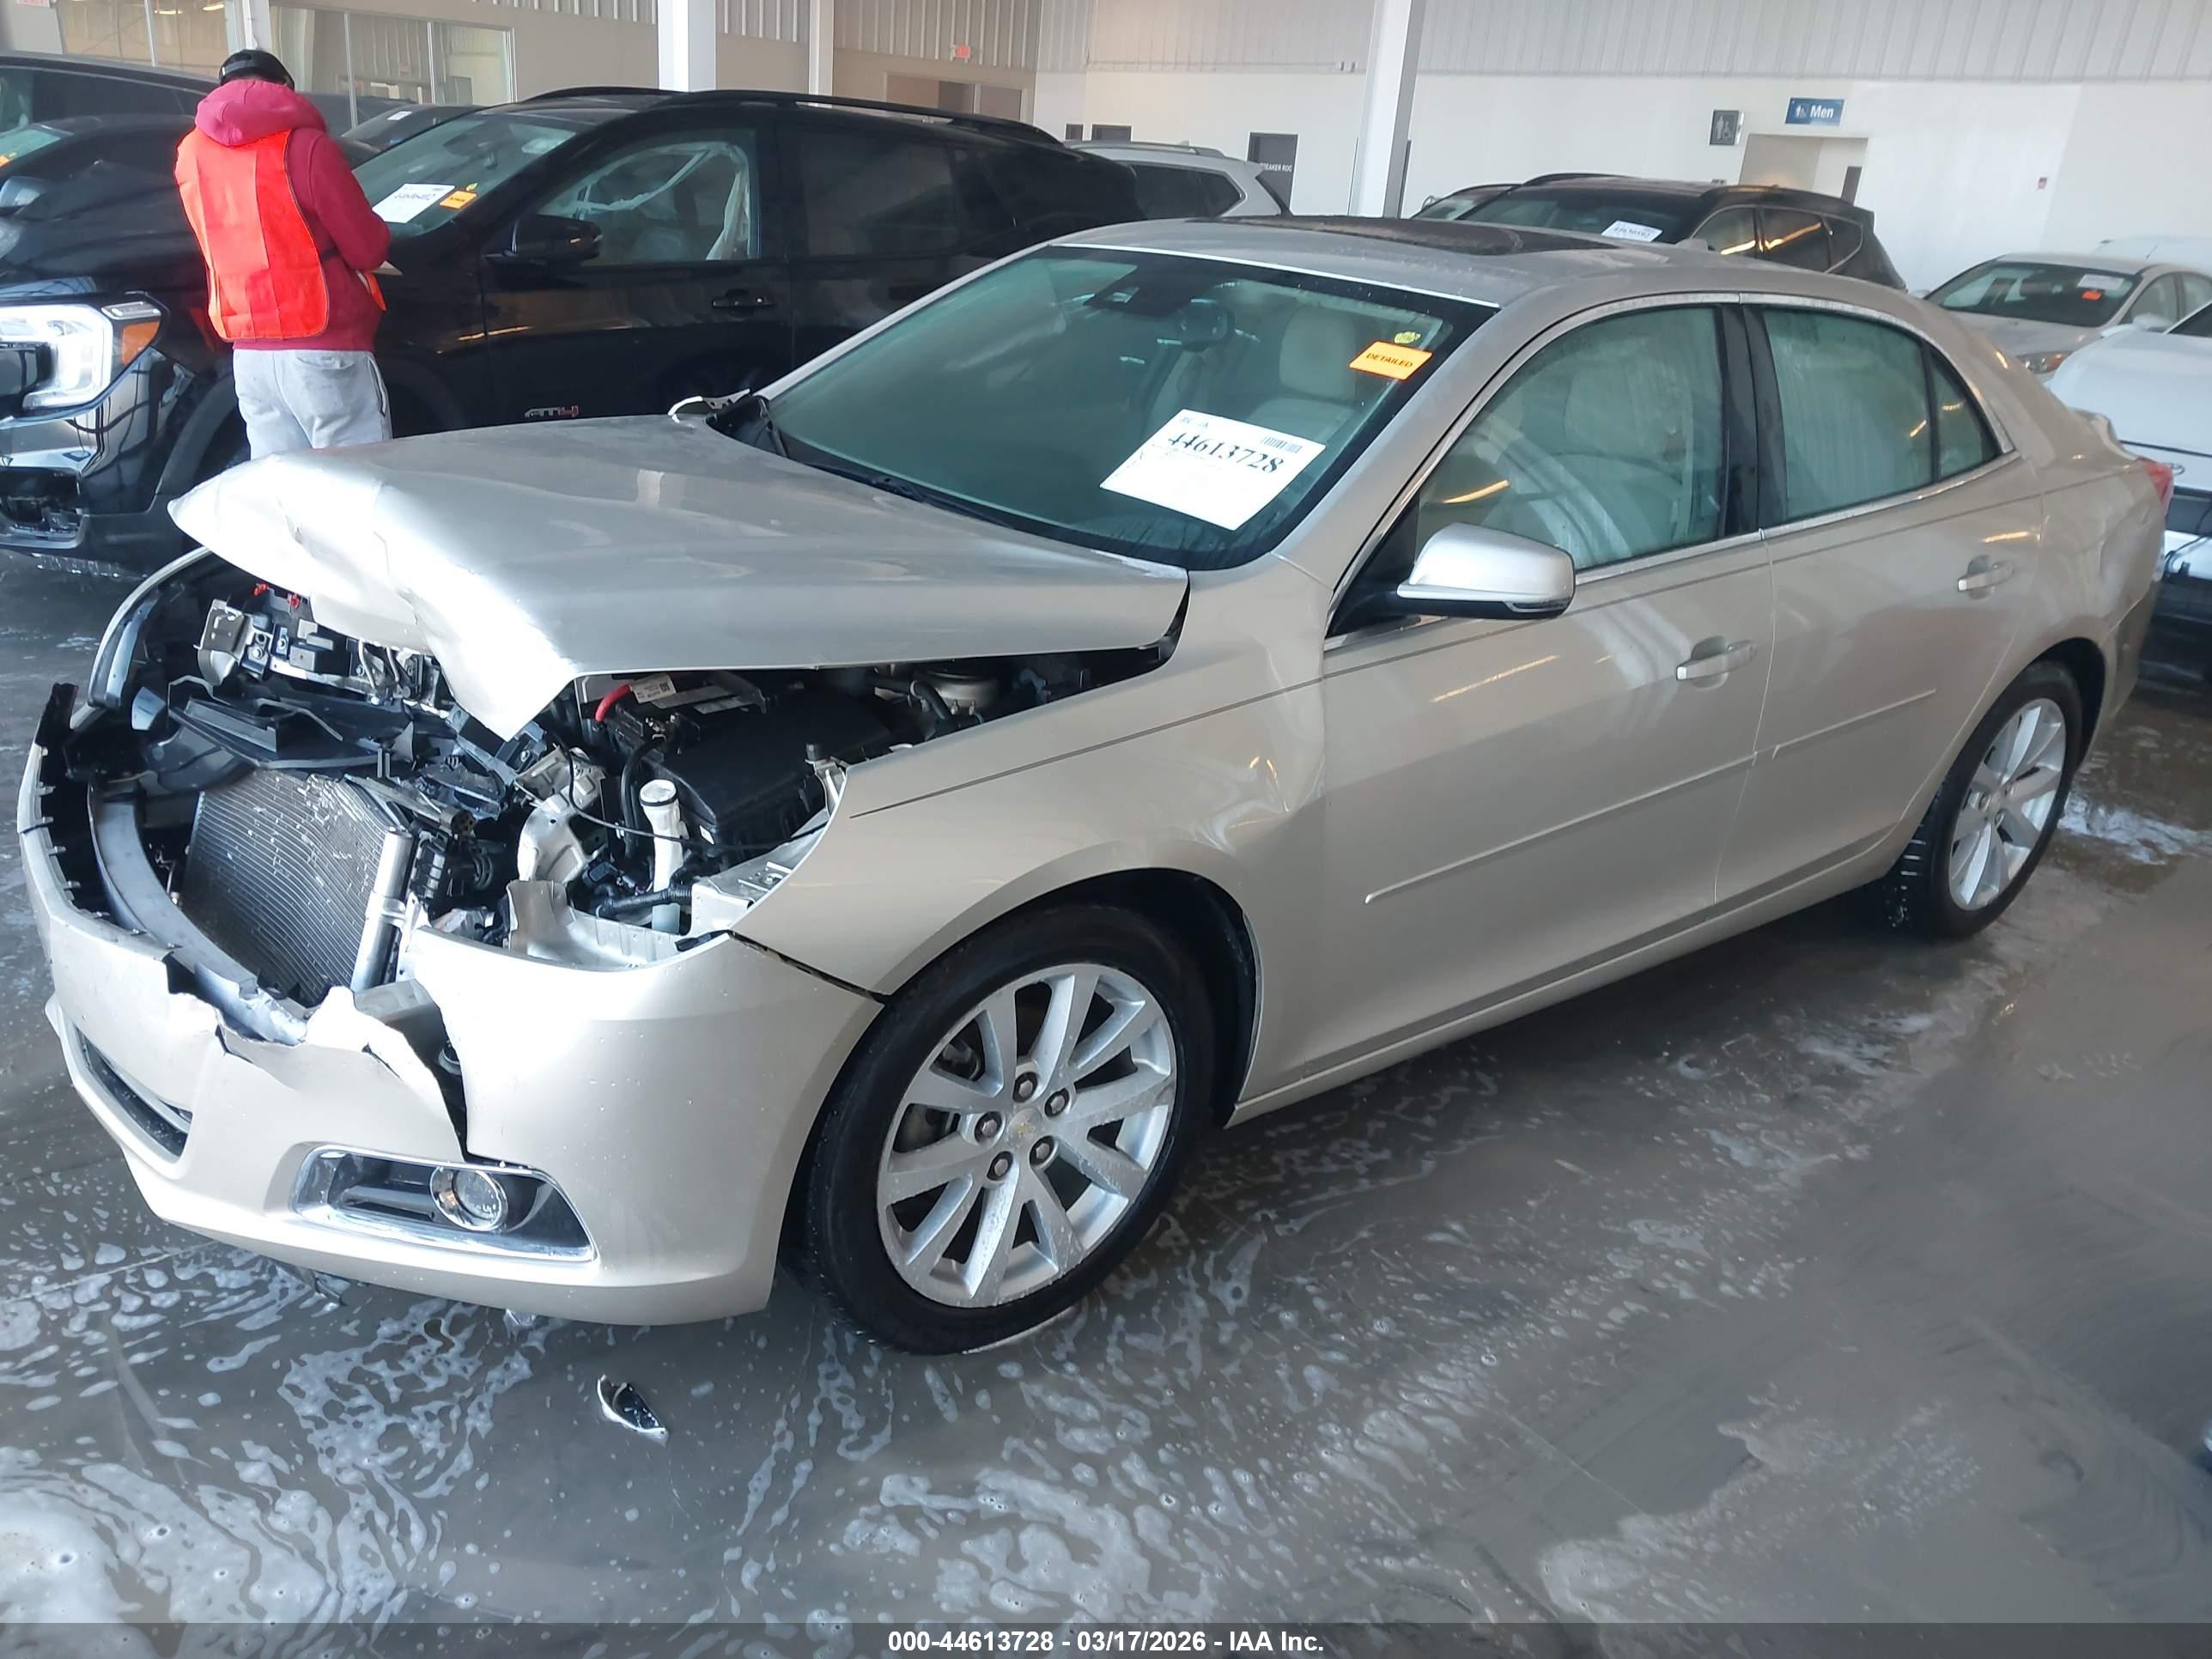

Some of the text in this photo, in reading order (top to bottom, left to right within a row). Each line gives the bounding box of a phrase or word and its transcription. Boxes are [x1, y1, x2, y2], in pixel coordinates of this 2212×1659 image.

[1809, 104, 1834, 119] Men
[1365, 352, 1413, 368] DETAILED
[1167, 432, 1285, 474] 44613728
